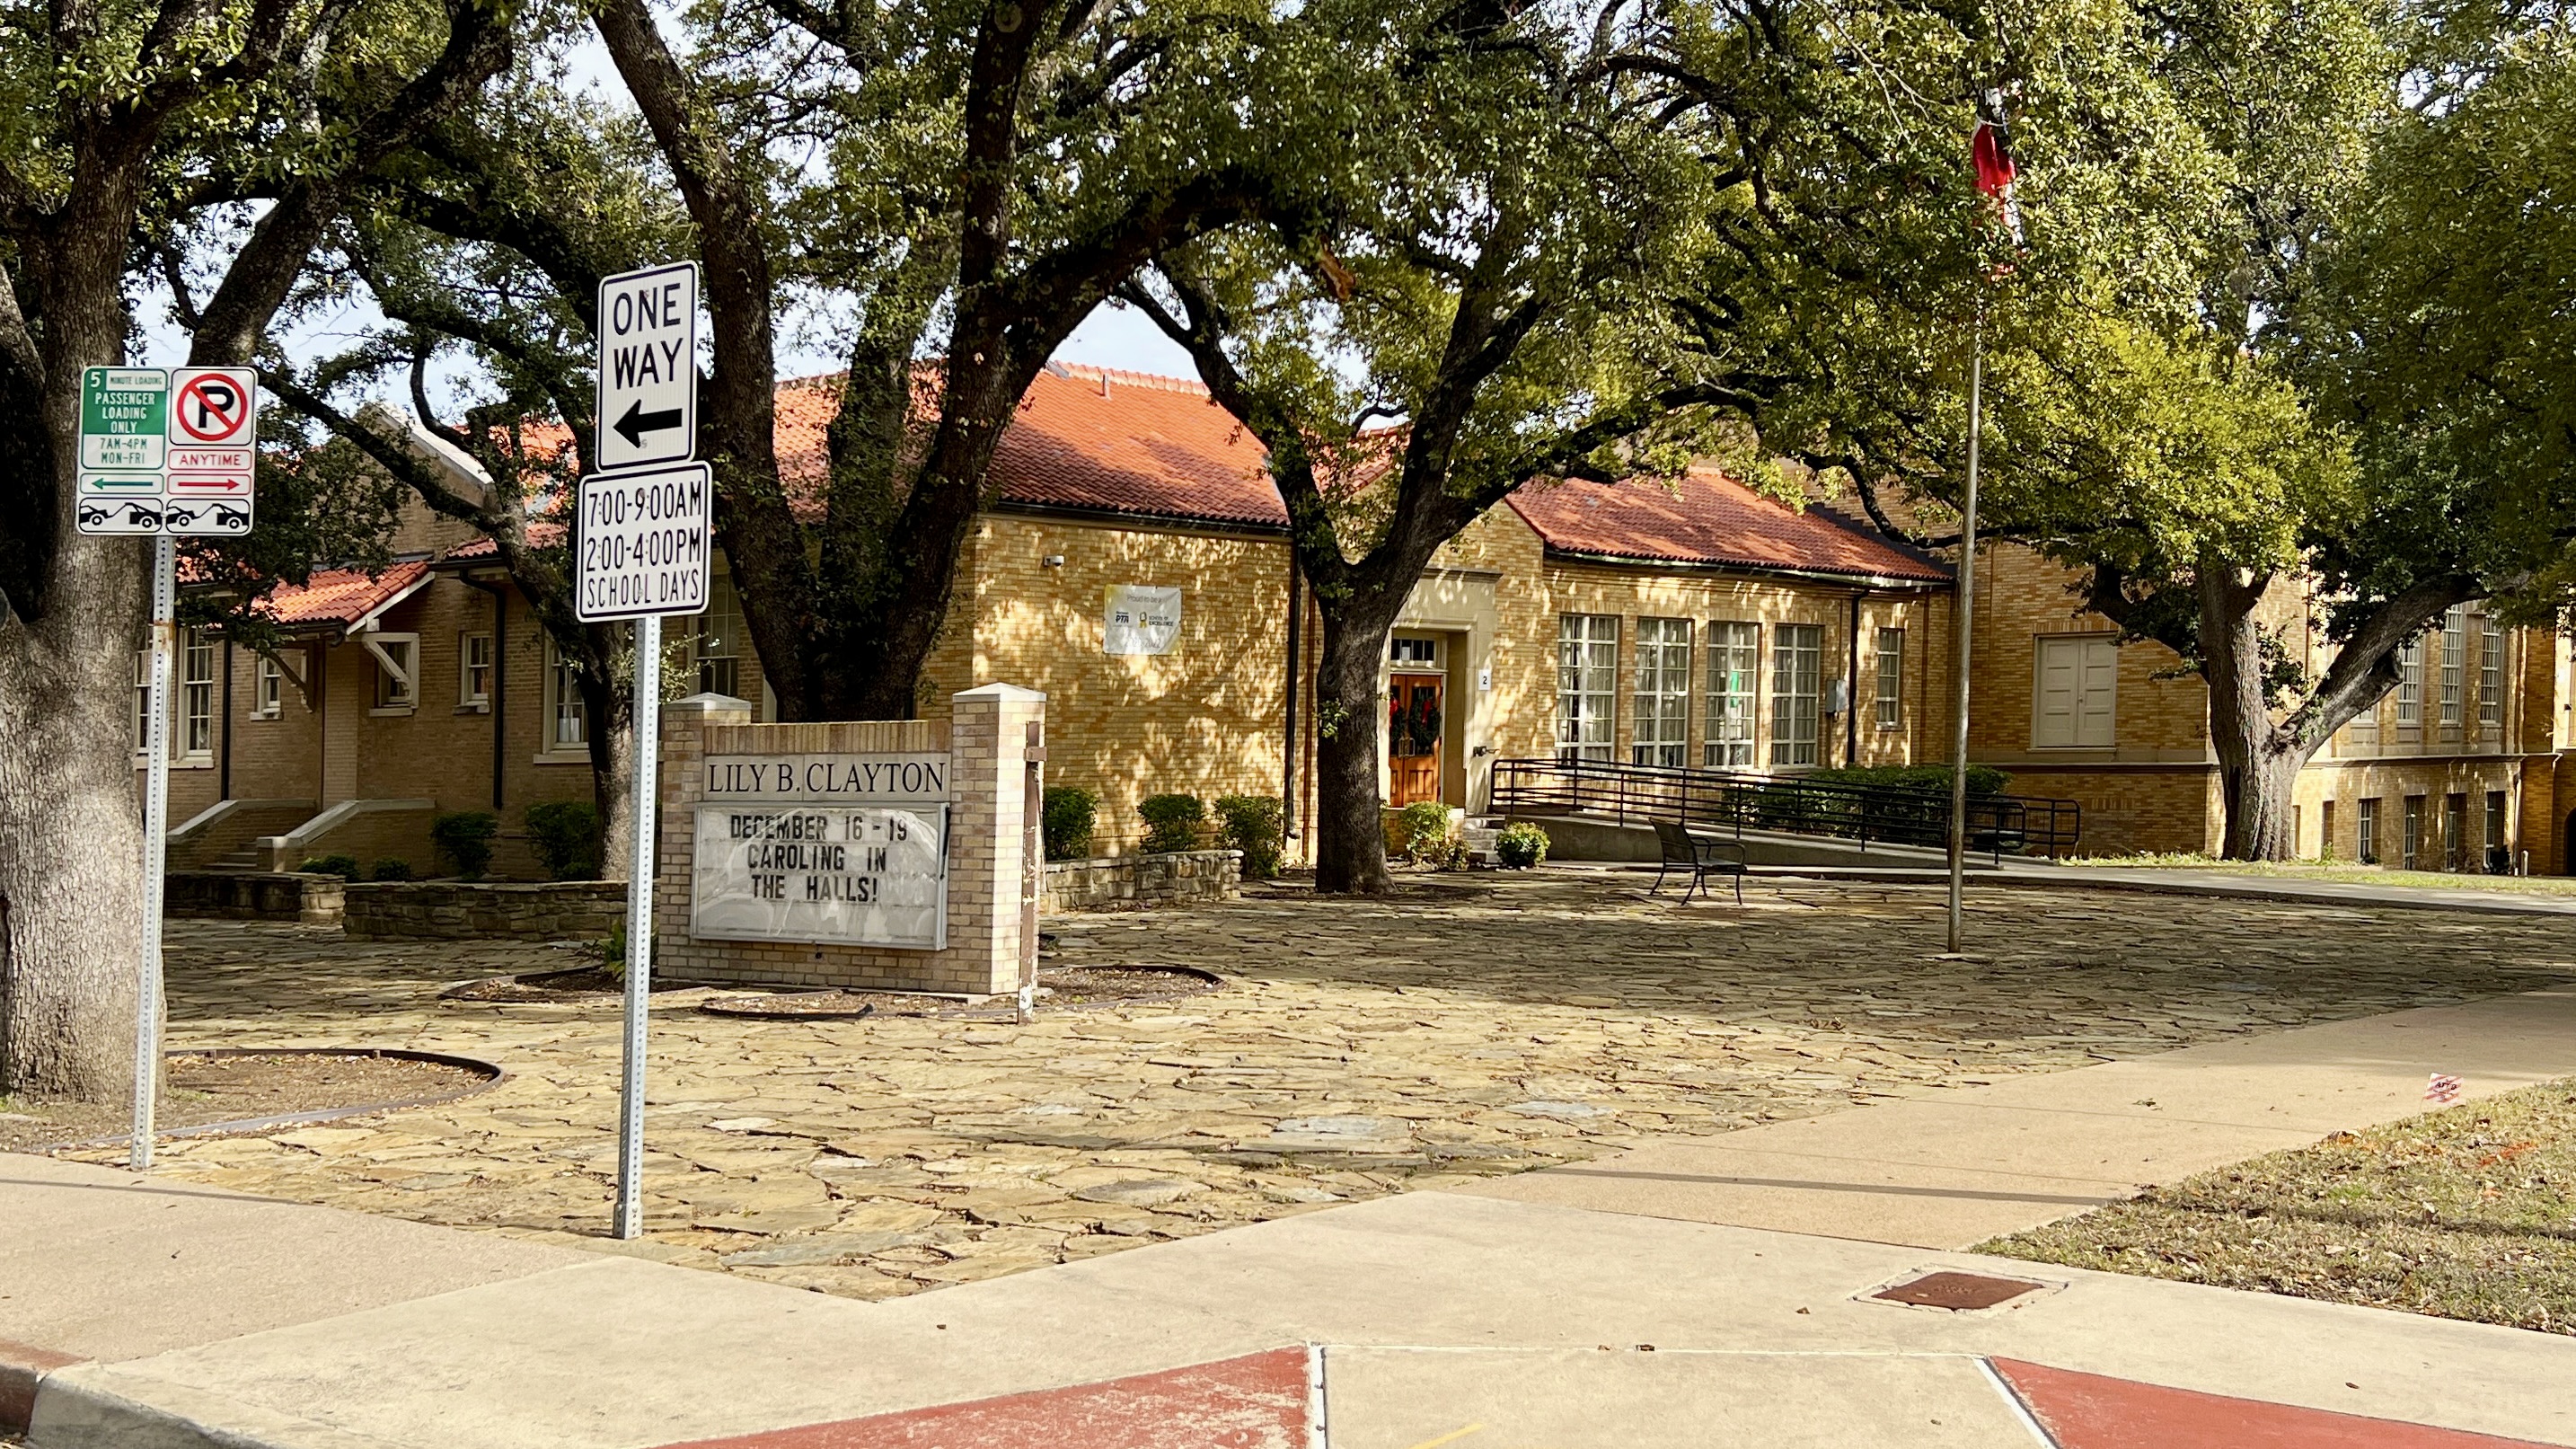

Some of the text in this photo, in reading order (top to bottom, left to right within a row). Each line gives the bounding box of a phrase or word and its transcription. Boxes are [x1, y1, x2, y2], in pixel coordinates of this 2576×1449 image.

[613, 283, 681, 335] ONE
[613, 338, 684, 390] WAY
[91, 372, 101, 387] 5
[110, 376, 162, 385] MINUTE LOADING
[95, 393, 155, 405] PASSENGER
[102, 407, 146, 420] LOADING
[110, 421, 137, 434] ONLY
[100, 437, 147, 450] 7AM-4PM
[101, 452, 146, 464] MON-FRI
[180, 454, 242, 466] ANYTIME
[587, 569, 699, 608] SCHOOL DAYS
[1483, 676, 1487, 685] 2
[708, 763, 946, 792] LILY B. CLAYTON
[731, 815, 827, 841] DECEMBER
[845, 816, 863, 841] 16
[889, 818, 907, 841] 19
[747, 844, 887, 872] CAROLING IN
[752, 875, 878, 902] THE HALLS!
